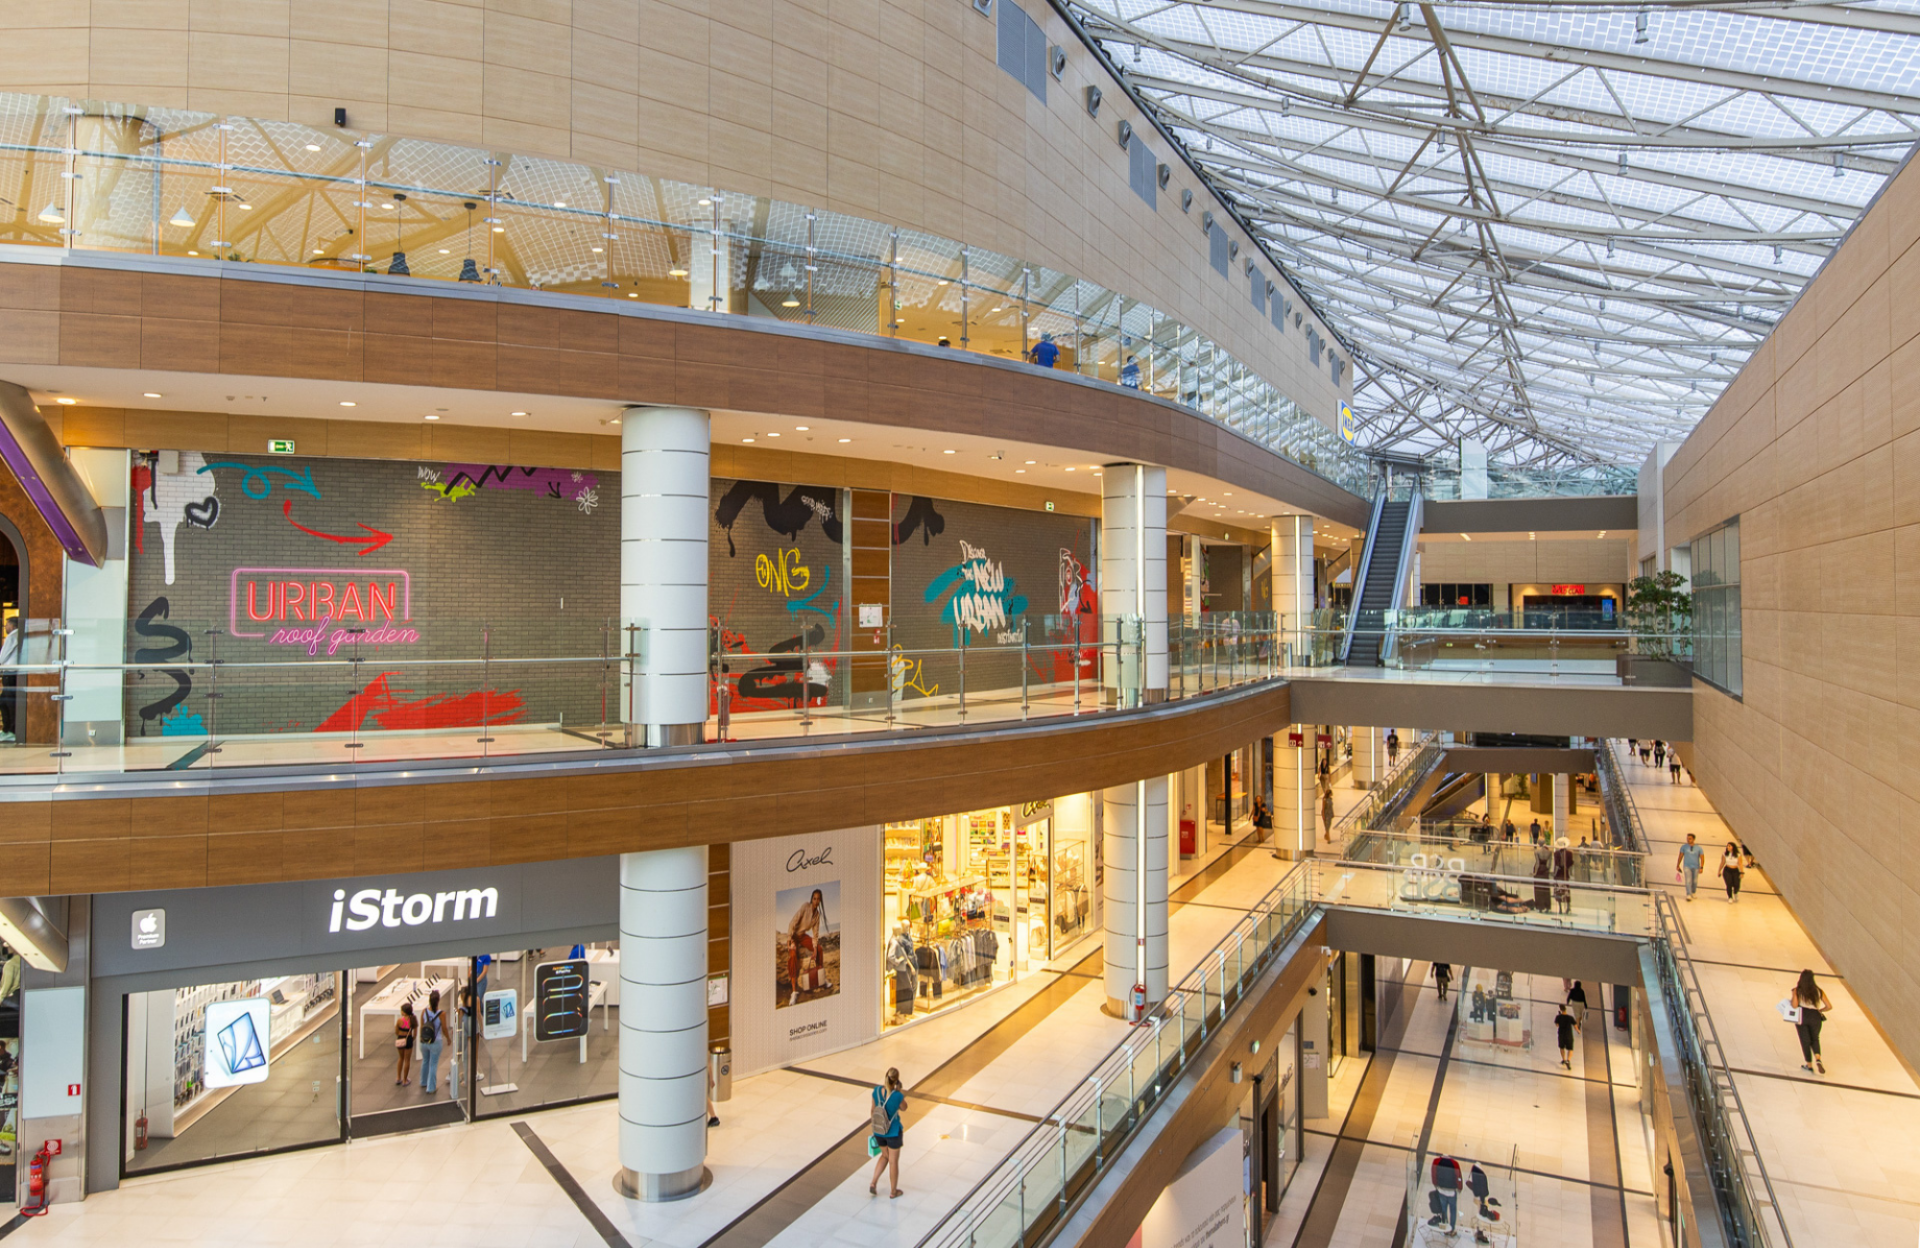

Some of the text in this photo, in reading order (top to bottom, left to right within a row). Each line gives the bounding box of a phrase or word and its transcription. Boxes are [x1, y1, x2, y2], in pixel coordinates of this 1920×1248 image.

[973, 558, 1004, 592] NEW
[247, 581, 396, 621] URBAN
[953, 593, 1006, 633] URBAN
[269, 615, 420, 656] roof garden
[329, 887, 498, 932] iStorm
[789, 1019, 828, 1036] SHOP ONLINE
